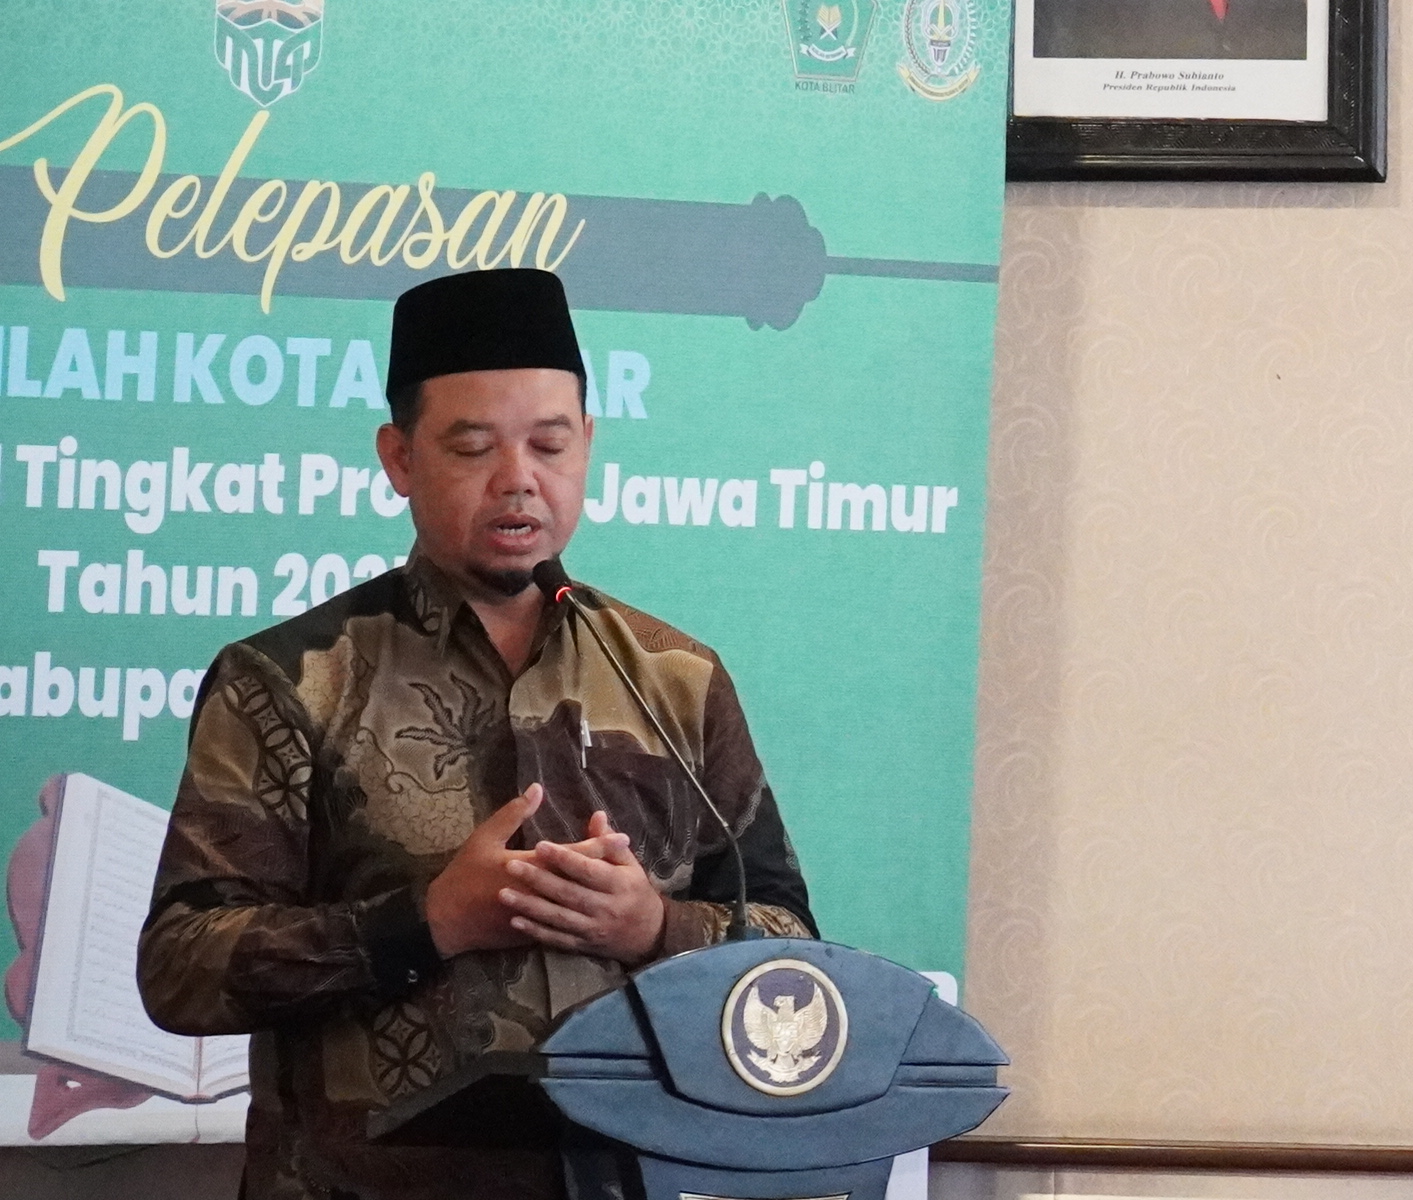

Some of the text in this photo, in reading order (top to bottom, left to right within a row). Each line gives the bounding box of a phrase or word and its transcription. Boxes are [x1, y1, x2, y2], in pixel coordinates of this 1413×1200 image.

[795, 81, 819, 91] KOTA
[1103, 83, 1236, 92] Presiden Republik Indonesia
[1115, 70, 1224, 80] H. Prabowo Subianto
[0, 83, 585, 315] Pelepasan
[0, 326, 157, 401] LAH
[173, 332, 386, 409] KOTA
[16, 435, 285, 534] Tingkat
[583, 462, 758, 528] Jawa
[770, 461, 958, 533] Timur
[37, 549, 258, 616] Tahun
